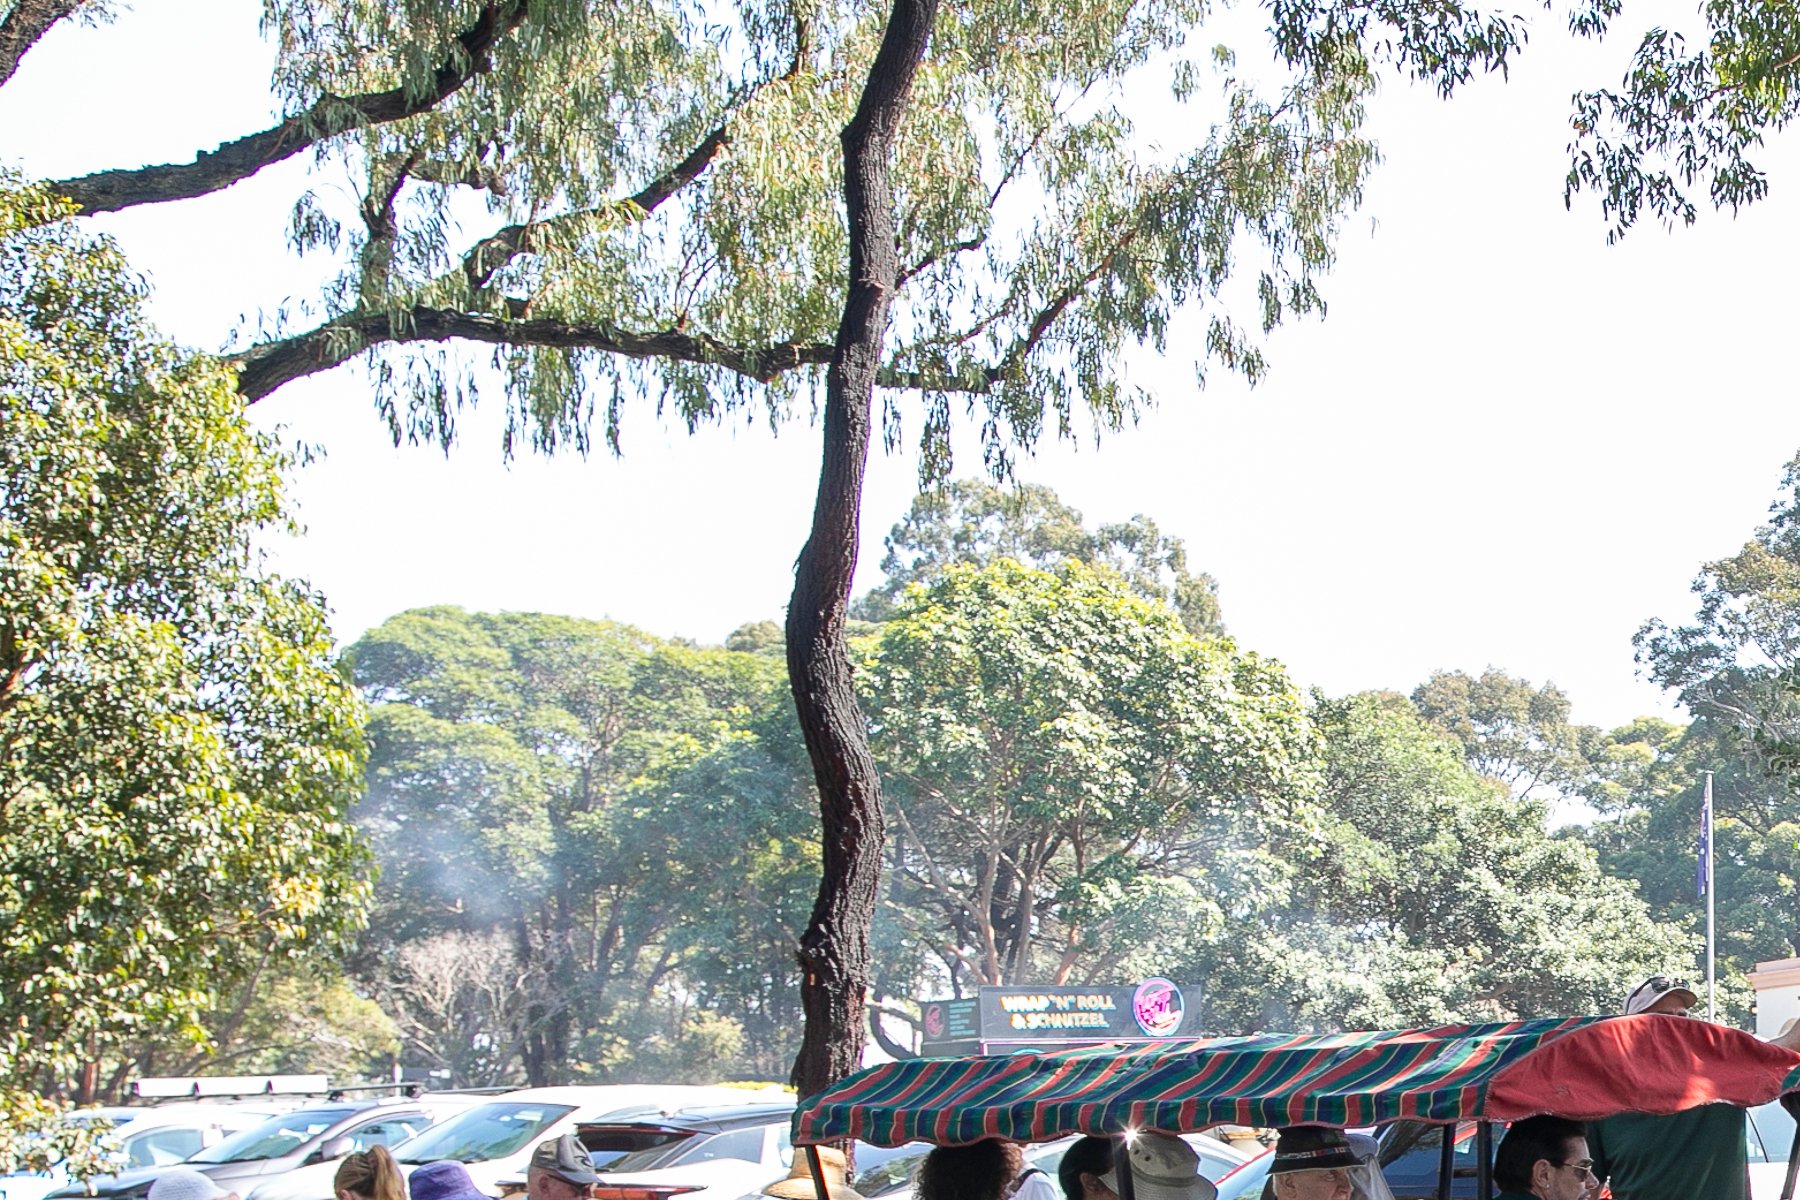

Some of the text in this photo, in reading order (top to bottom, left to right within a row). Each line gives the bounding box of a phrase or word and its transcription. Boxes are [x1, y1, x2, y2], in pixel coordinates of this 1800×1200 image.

[1001, 994, 1049, 1012] WRAP
[1077, 994, 1116, 1010] ROLL
[1010, 1012, 1110, 1029] & SCHNITZEL
